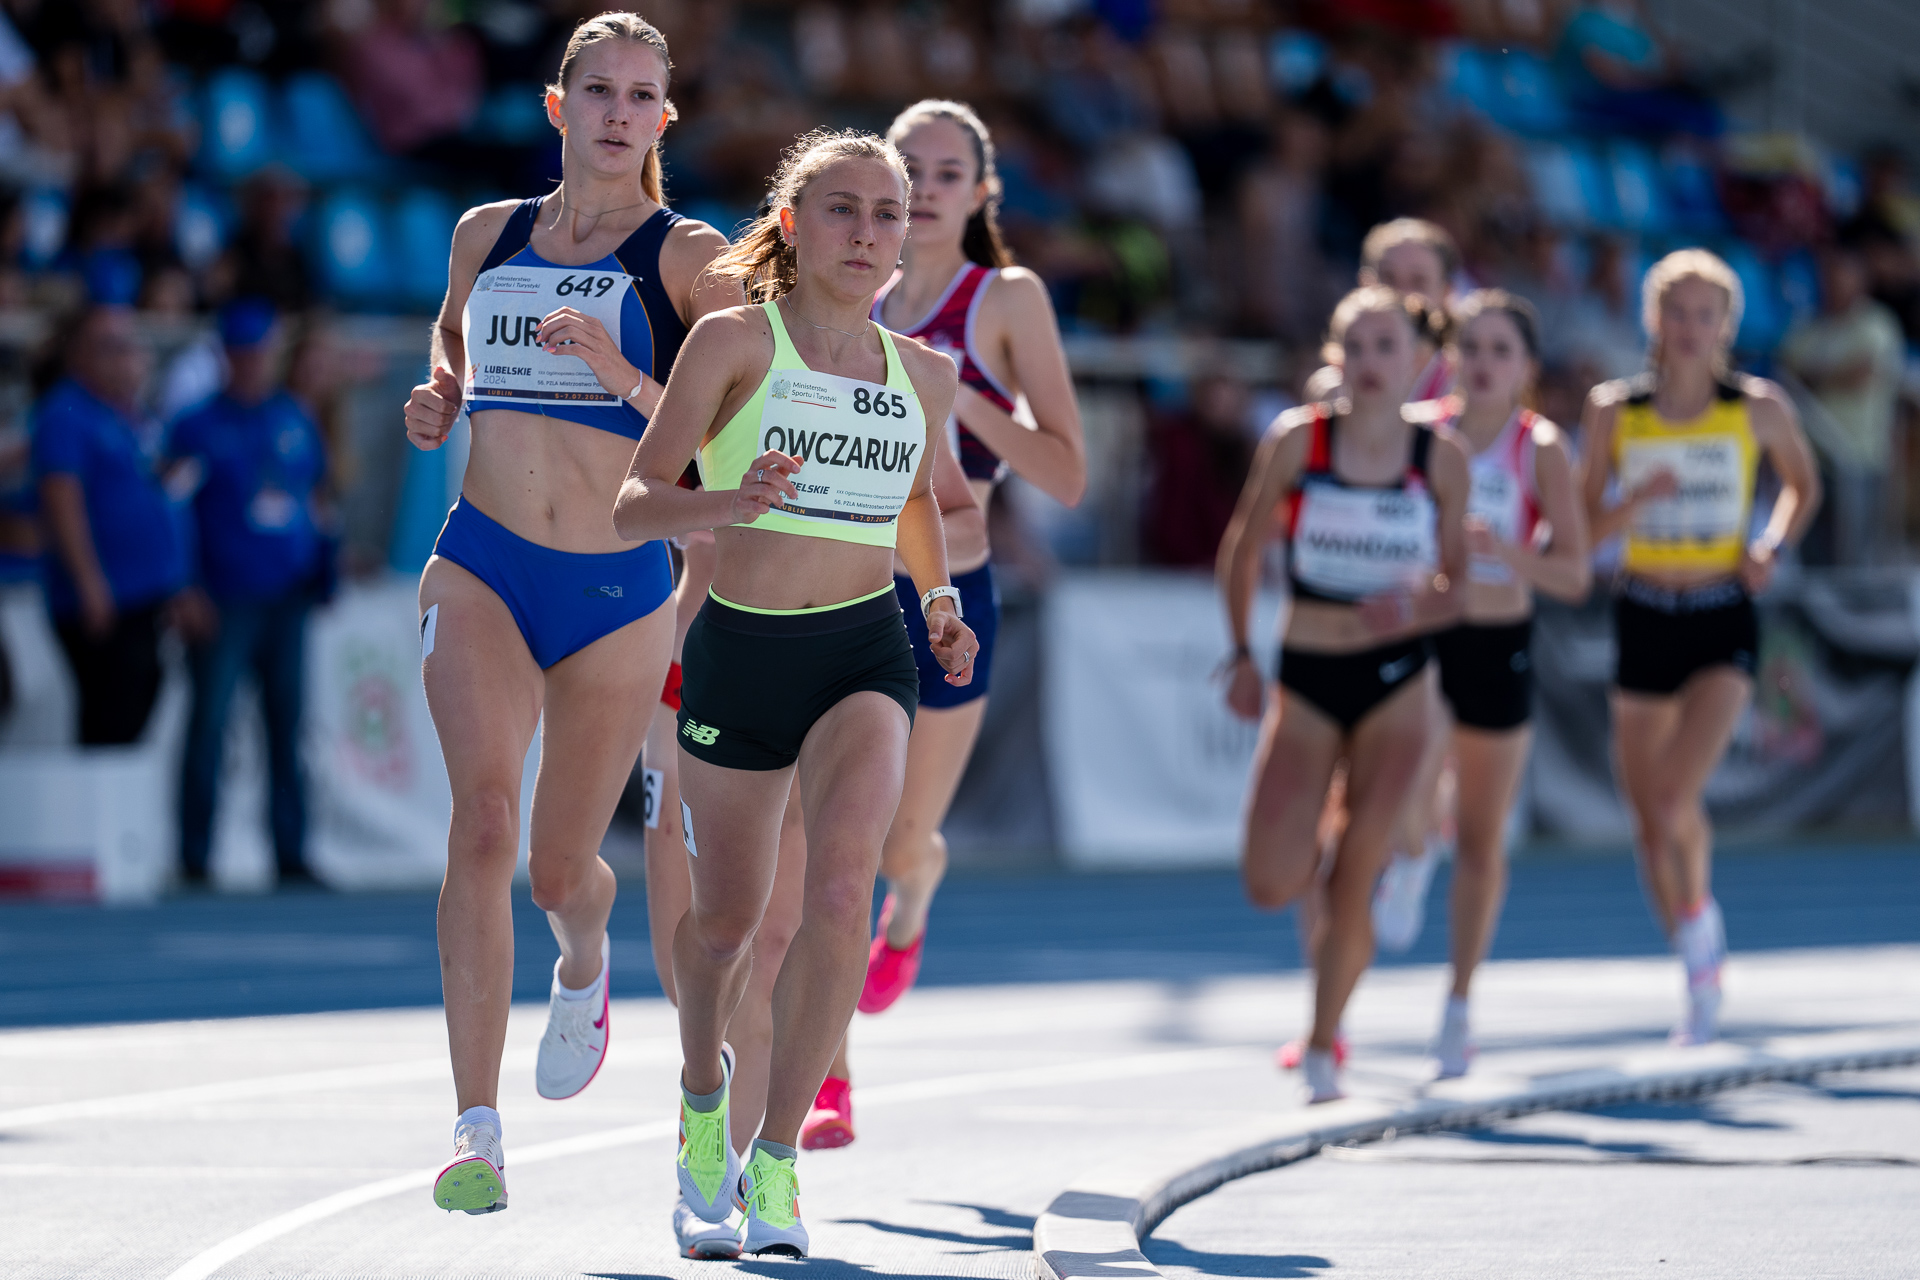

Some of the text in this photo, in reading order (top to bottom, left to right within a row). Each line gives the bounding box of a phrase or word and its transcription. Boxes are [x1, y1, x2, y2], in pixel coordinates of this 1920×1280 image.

[516, 282, 541, 290] Turystyki
[556, 275, 615, 298] 649
[486, 314, 576, 348] JUR
[484, 364, 532, 376] LUBELSKIE
[483, 375, 506, 384] 2024
[487, 389, 513, 397] LUBLIN
[792, 382, 828, 393] Ministerstwo
[791, 389, 812, 399] Sportu
[816, 392, 837, 403] Turystyki
[853, 387, 907, 419] 865
[764, 426, 918, 473] OWCZARUK
[856, 502, 884, 510] Mistrzostwa
[850, 514, 890, 522] 5-7.07.2024
